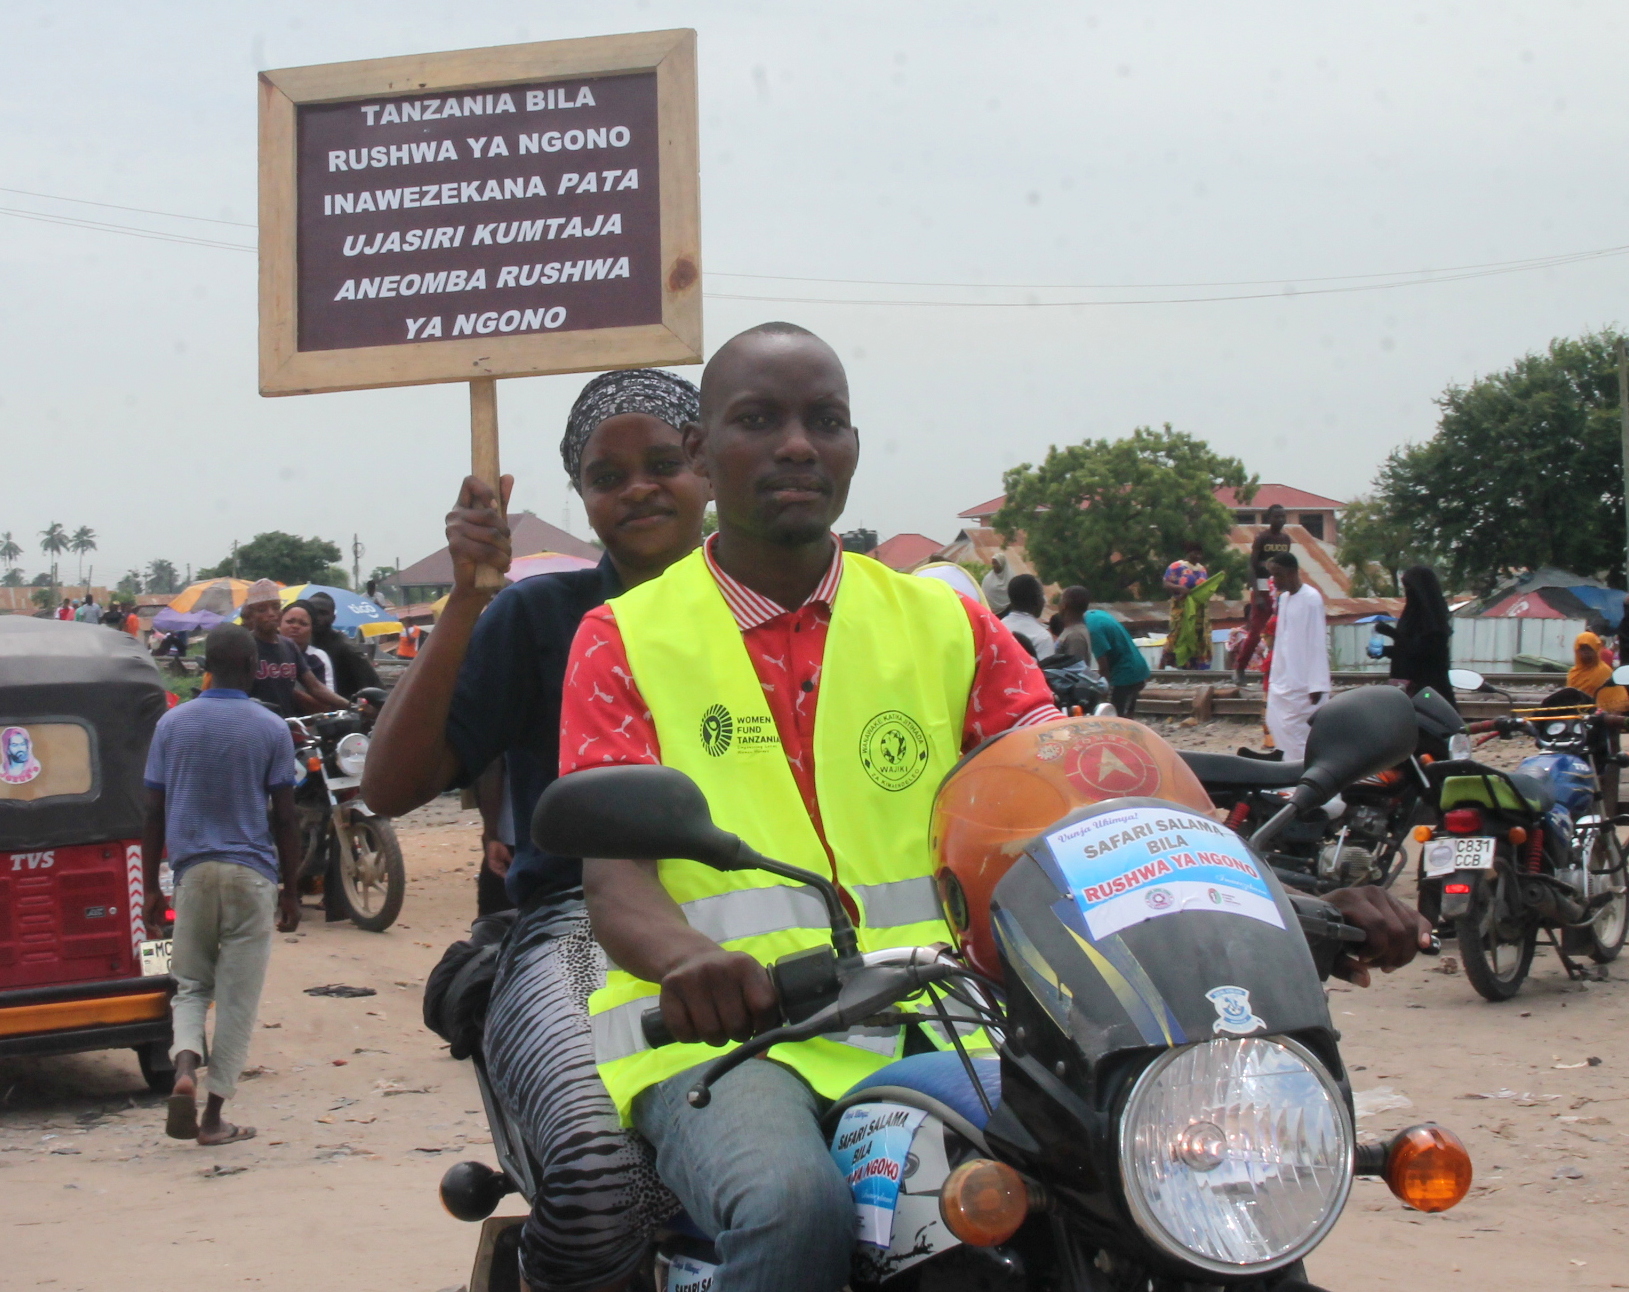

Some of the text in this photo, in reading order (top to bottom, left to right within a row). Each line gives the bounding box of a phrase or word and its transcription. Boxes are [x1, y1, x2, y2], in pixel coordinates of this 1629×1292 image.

[361, 86, 596, 126] TANZANIA BILA
[328, 126, 631, 172] RUSHWA YA NGONO
[324, 169, 639, 215] INAWEZEKANA PATA
[343, 213, 622, 256] UJASIRI KUMTAJA
[334, 256, 630, 301] ANEOMBA RUSHWA
[404, 306, 567, 340] YA NGONO
[736, 715, 771, 724] WOMEN
[736, 726, 762, 734] FUND
[1058, 826, 1092, 843] Vunja
[1084, 818, 1224, 859] SAFARI SALAMA
[1146, 834, 1189, 855] BILA
[10, 850, 55, 871] TVS
[1084, 859, 1171, 903] RUSHWA
[1171, 853, 1198, 869] YA
[1200, 852, 1259, 879] NGONO
[1455, 854, 1481, 867] CCB
[838, 1124, 868, 1150] SAFARI
[867, 1111, 909, 1136] SALAMA
[852, 1141, 872, 1166] BILA
[865, 1158, 899, 1181] NGONO
